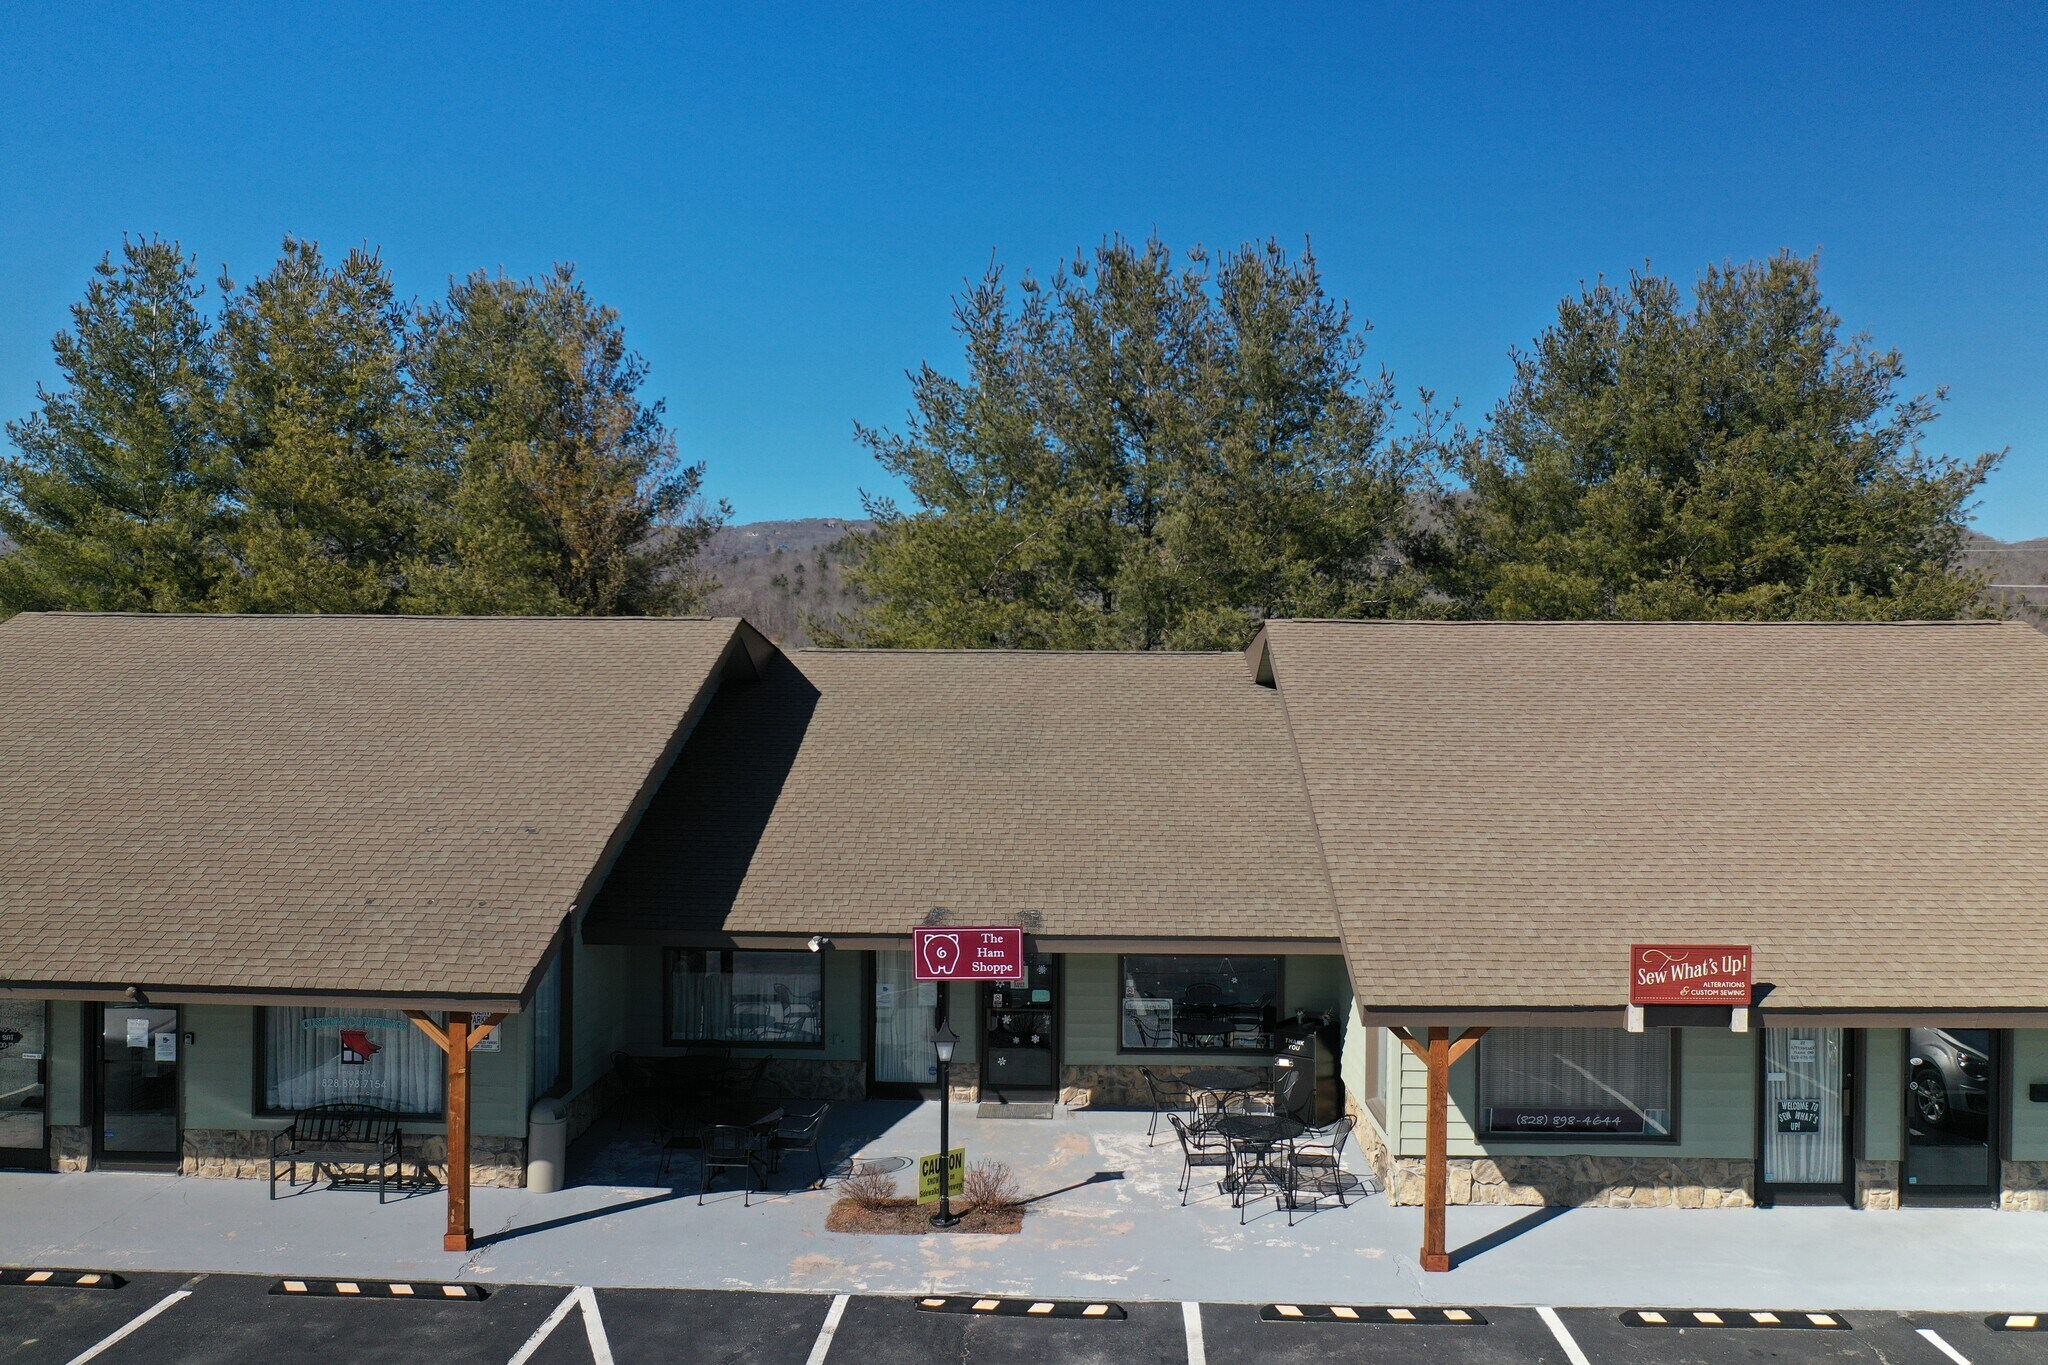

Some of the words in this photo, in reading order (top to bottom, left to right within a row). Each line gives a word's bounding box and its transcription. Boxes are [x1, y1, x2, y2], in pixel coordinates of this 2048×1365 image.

[981, 933, 1004, 944] The
[977, 947, 1005, 958] Ham
[972, 961, 1013, 975] Shoppe
[1637, 967, 1668, 985] Sew
[1671, 958, 1718, 982] What's
[1722, 955, 1747, 976] Up!
[1680, 986, 1690, 996] &
[1285, 1037, 1305, 1046] THANK
[321, 1078, 387, 1089] 828.898.7154
[1781, 1101, 1809, 1111] WELCOME
[1810, 1102, 1819, 1112] TO
[1516, 1113, 1548, 1126] (828)
[1552, 1115, 1622, 1129] 898-4644
[1778, 1111, 1792, 1122] SEW
[1795, 1111, 1819, 1125] WHAT'S
[1790, 1121, 1801, 1131] UP!
[922, 1152, 962, 1177] CAUON
